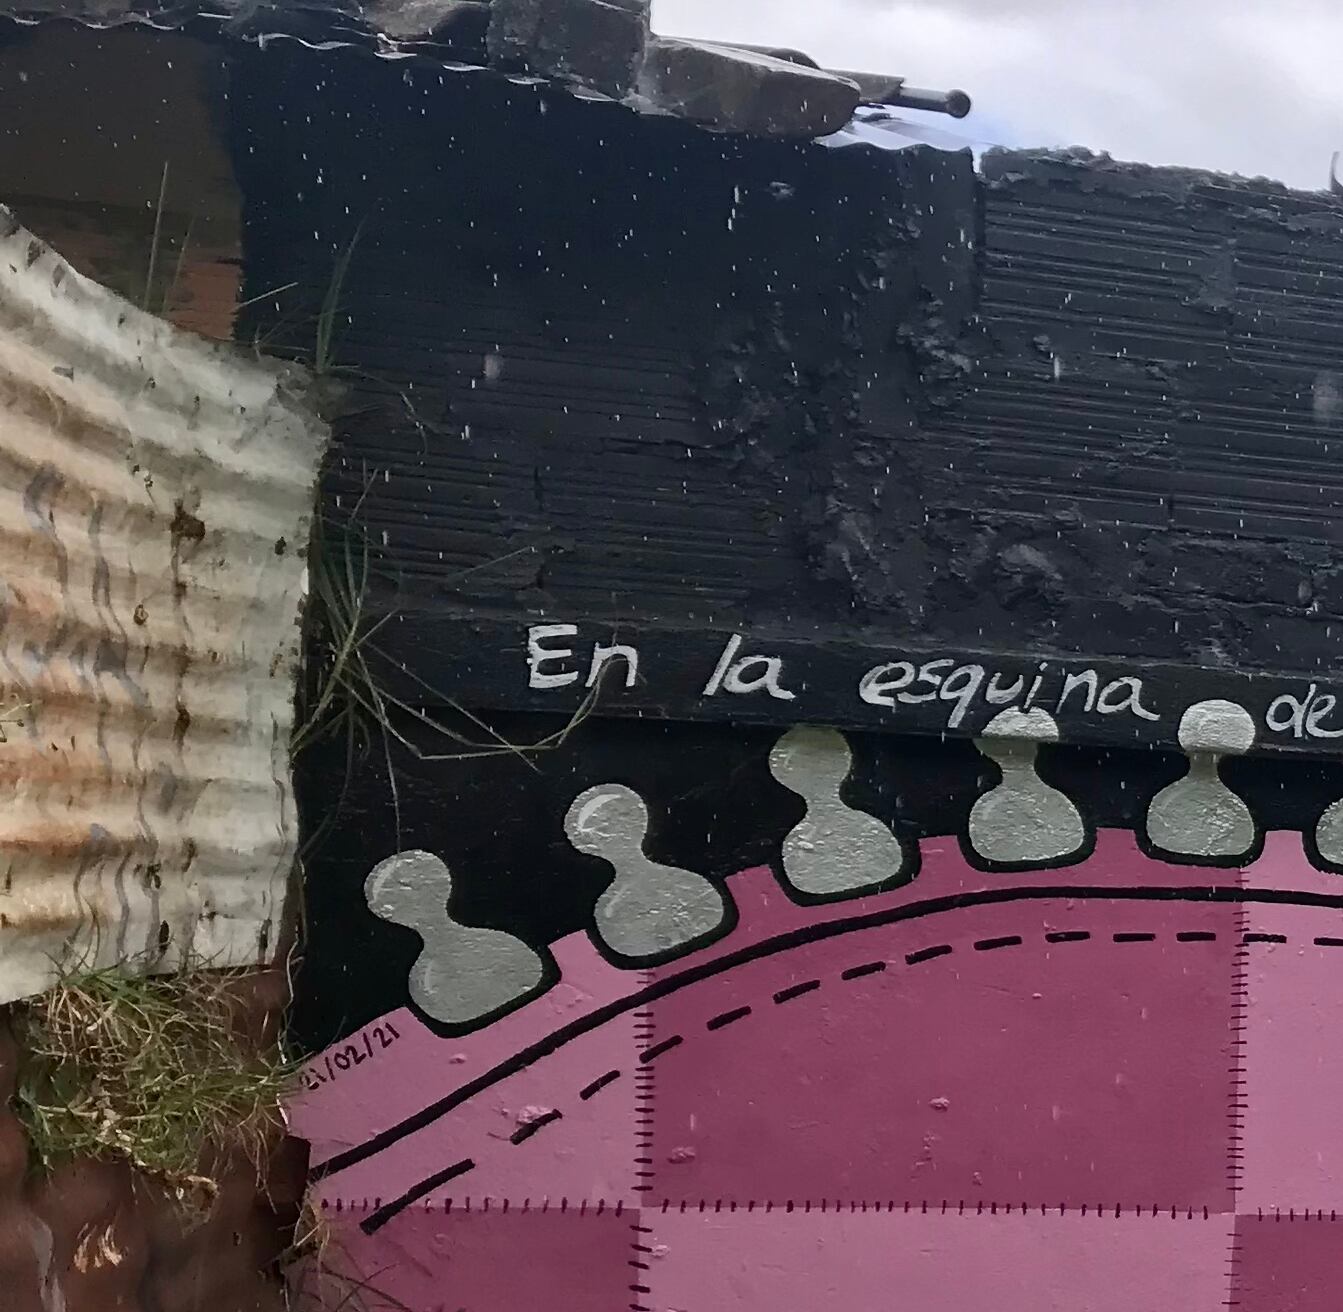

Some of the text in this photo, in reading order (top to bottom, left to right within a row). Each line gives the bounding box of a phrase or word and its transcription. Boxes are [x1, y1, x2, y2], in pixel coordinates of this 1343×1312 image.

[526, 624, 637, 689] En
[701, 633, 797, 700] la
[859, 657, 1161, 729] esquina
